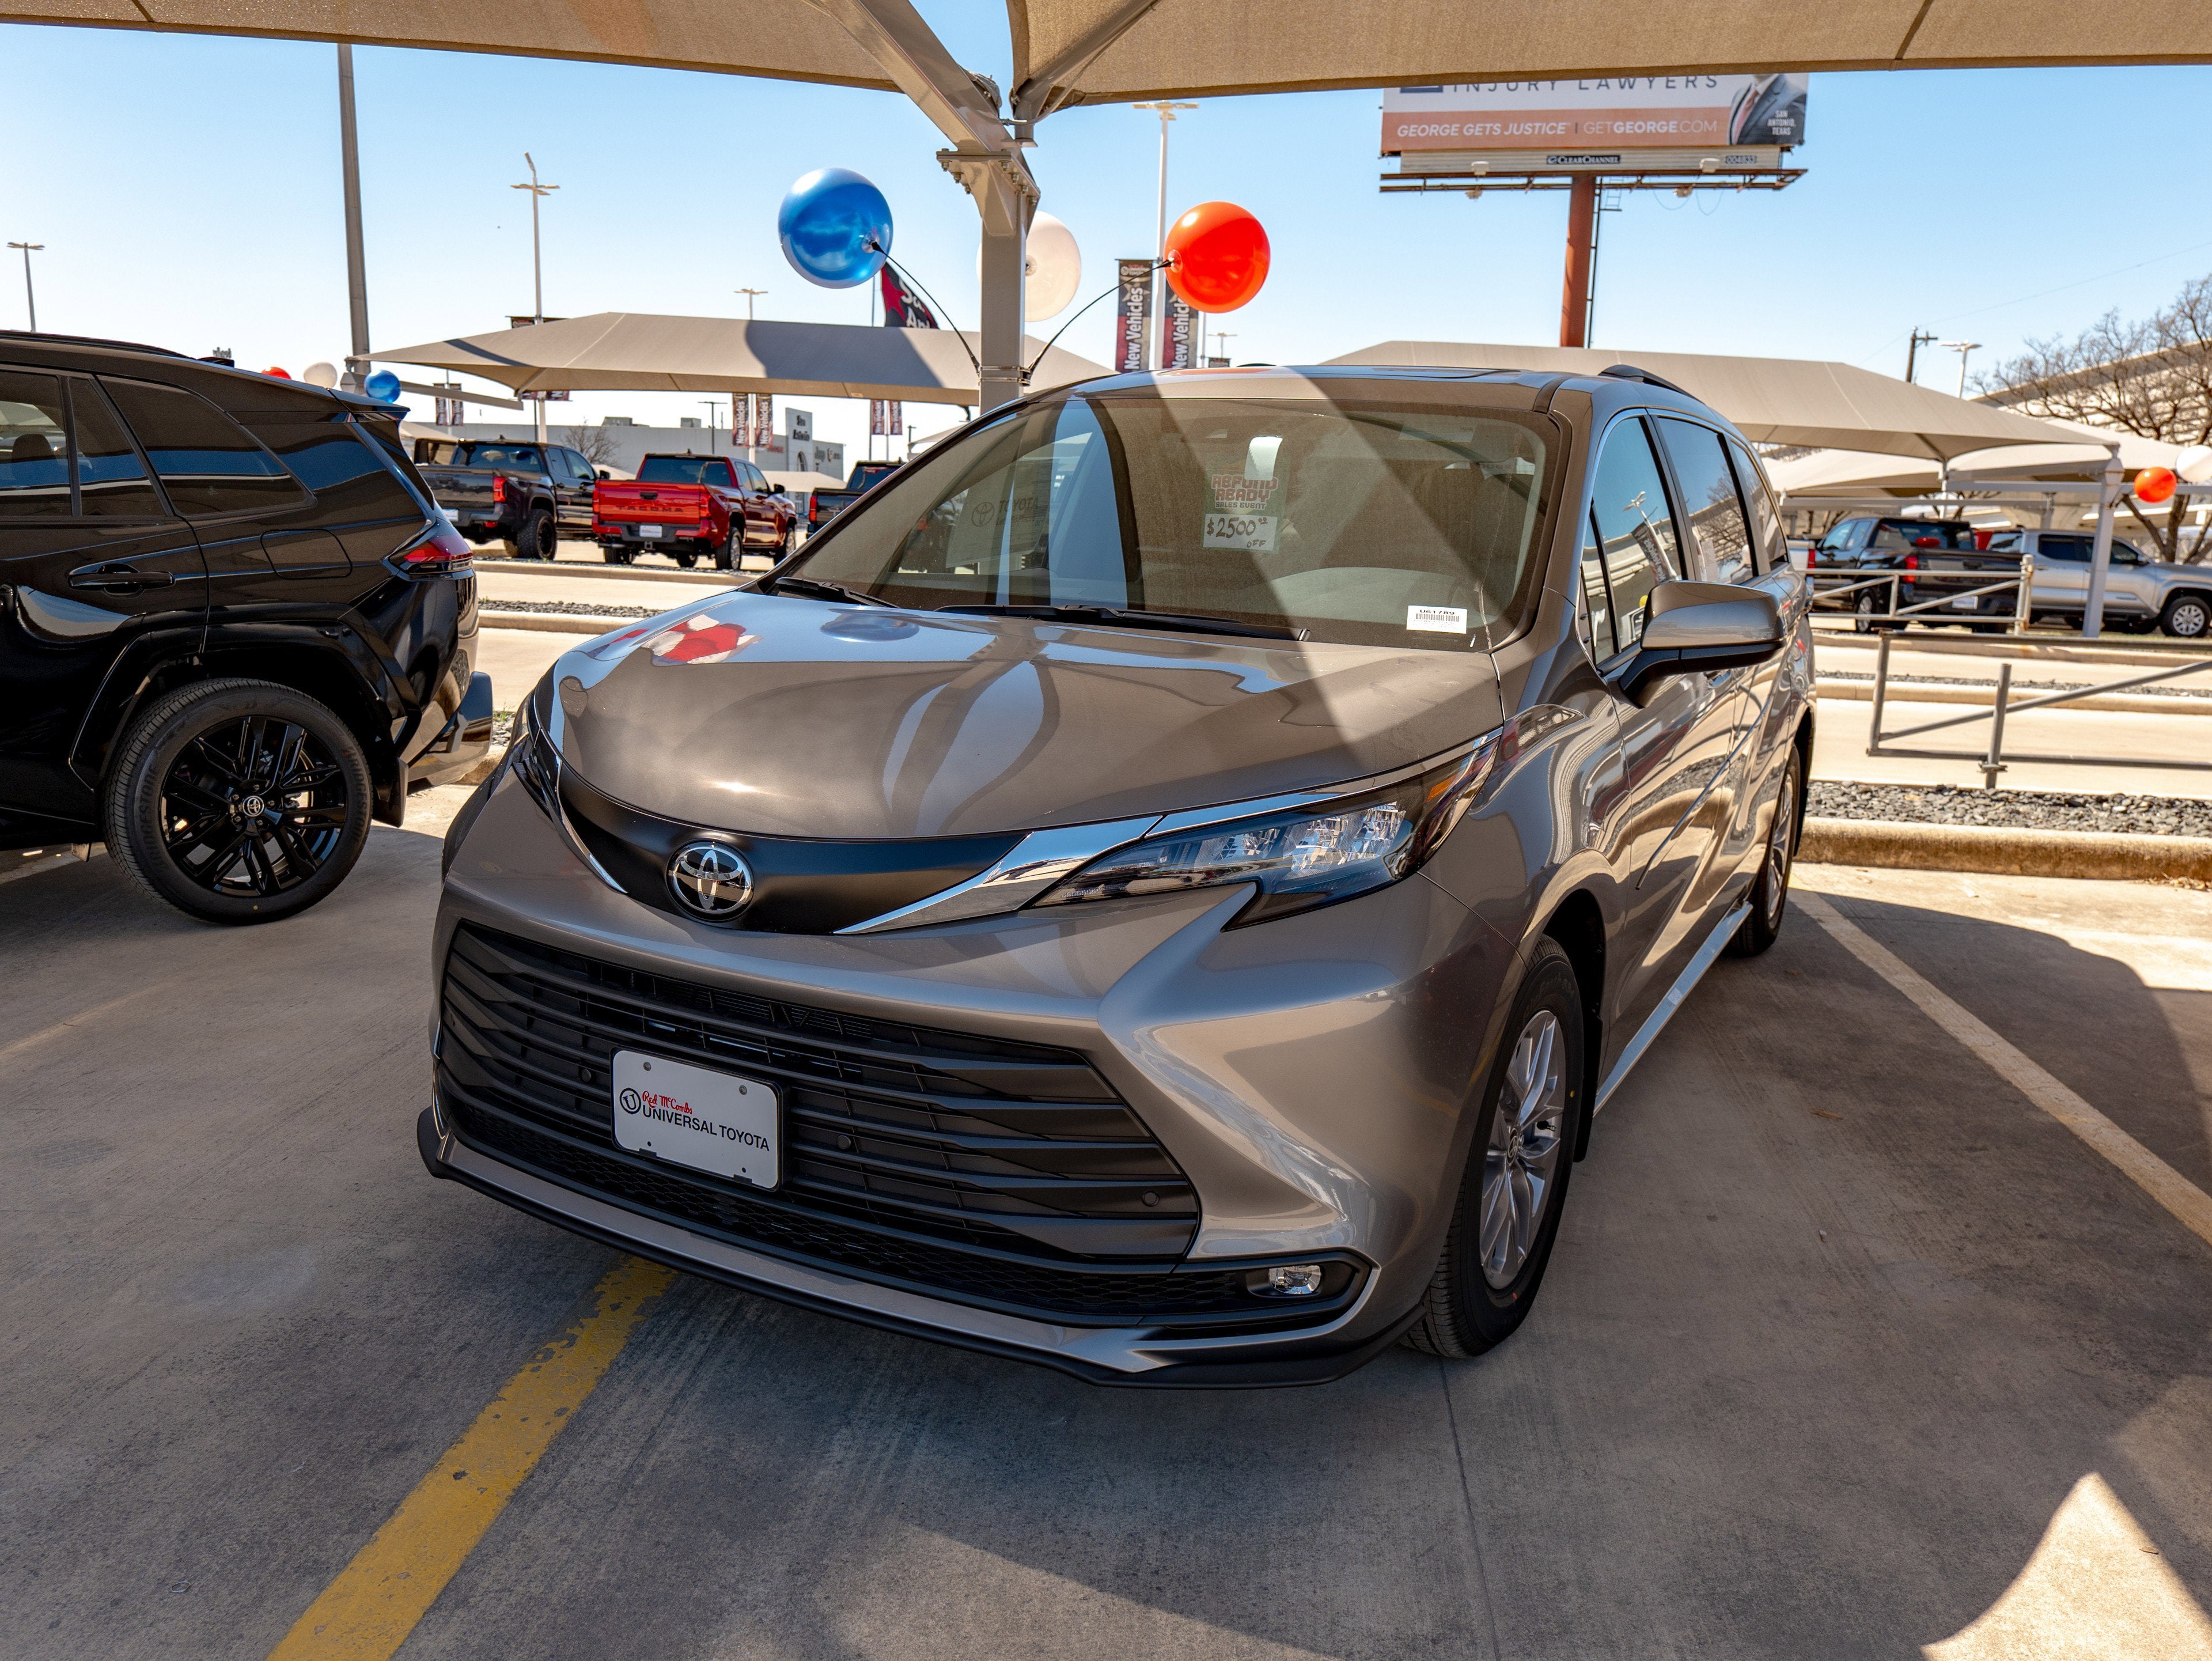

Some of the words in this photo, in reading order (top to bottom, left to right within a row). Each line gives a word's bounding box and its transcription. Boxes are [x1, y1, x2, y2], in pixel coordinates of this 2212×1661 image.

[1578, 75, 1718, 90] LAWYERS
[1396, 123, 1460, 138] GEORGE
[1463, 123, 1502, 136] GETS
[1503, 122, 1567, 135] JUSTICE
[1125, 287, 1143, 340] Vehicles
[1124, 342, 1141, 370] New
[1172, 343, 1188, 369] New
[1212, 475, 1278, 490] REFUND
[1215, 489, 1271, 502] READY
[642, 1091, 658, 1108] Red
[658, 1095, 692, 1114] McCombs
[643, 1104, 718, 1136] UNIVERSAL
[719, 1124, 770, 1152] TOYOTA
